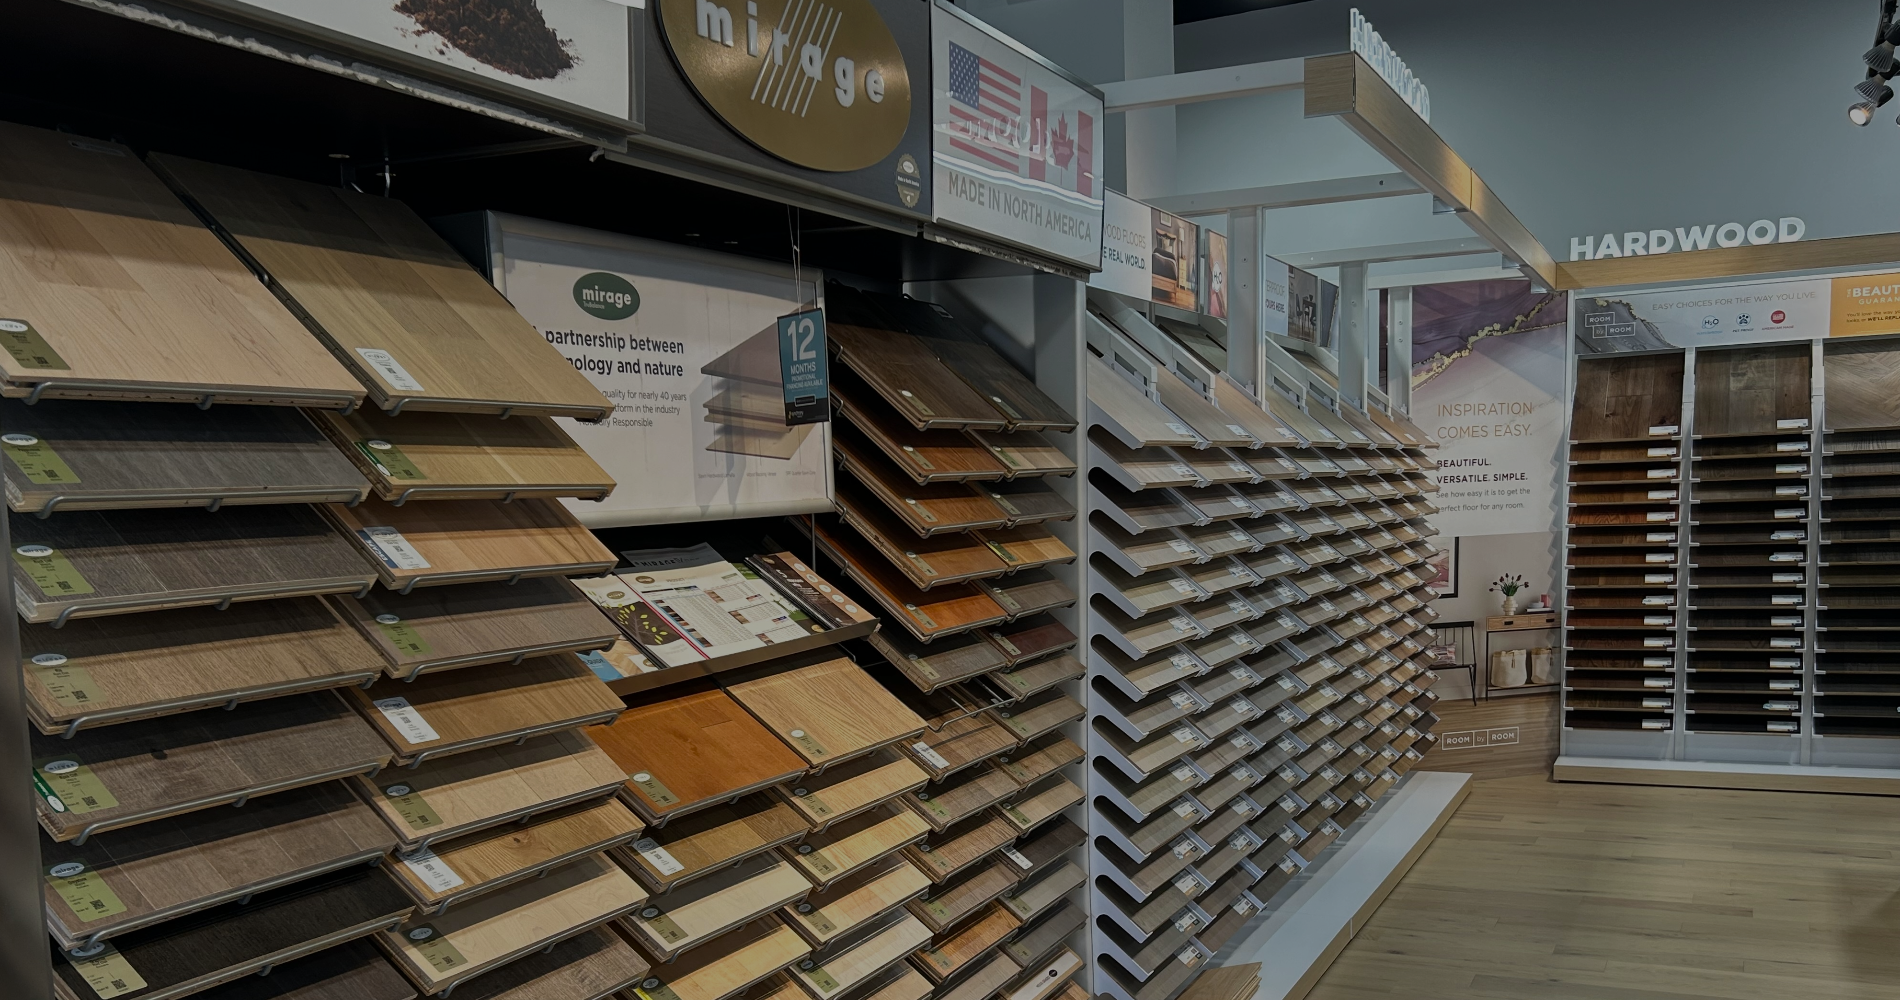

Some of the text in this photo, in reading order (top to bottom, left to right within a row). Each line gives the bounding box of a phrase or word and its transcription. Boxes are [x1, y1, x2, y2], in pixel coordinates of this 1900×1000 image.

[696, 0, 885, 107] mirage
[949, 172, 1091, 243] MADE IN NORTH AMERICA
[1569, 216, 1806, 261] HARDWOOD
[1108, 248, 1124, 263] REAL
[1124, 252, 1146, 270] WORLD.
[582, 285, 632, 308] mirage
[1852, 284, 1900, 298] BEAUT
[1652, 301, 1674, 311] EASY
[1676, 300, 1712, 309] CHOICES
[1714, 298, 1732, 306] FOR
[1736, 296, 1752, 304] THE
[1754, 294, 1774, 302] WAY
[1776, 293, 1794, 301] YOU
[1858, 296, 1900, 305] GUARAN
[1610, 326, 1632, 334] ROOM
[545, 330, 684, 354] partnership between
[787, 318, 816, 362] 12
[617, 359, 641, 374] and
[644, 361, 684, 376] nature
[790, 362, 816, 374] MONTHS
[791, 374, 816, 382] PROMOTIONAL
[627, 390, 637, 399] for
[638, 390, 658, 401] nearly
[660, 391, 670, 400] 40
[670, 393, 687, 402] years
[634, 404, 641, 412] in
[642, 404, 654, 414] the
[654, 404, 680, 415] industry
[1437, 402, 1533, 418] INSPIRATION
[612, 417, 653, 428] Responsible
[1437, 424, 1532, 440] COMES EASY.
[1436, 458, 1492, 468] BEAUTIFUL.
[1436, 472, 1528, 484] VERSATILE. SIMPLE.
[1446, 732, 1514, 744] ROOM by ROOM
[54, 866, 80, 874] mirage
